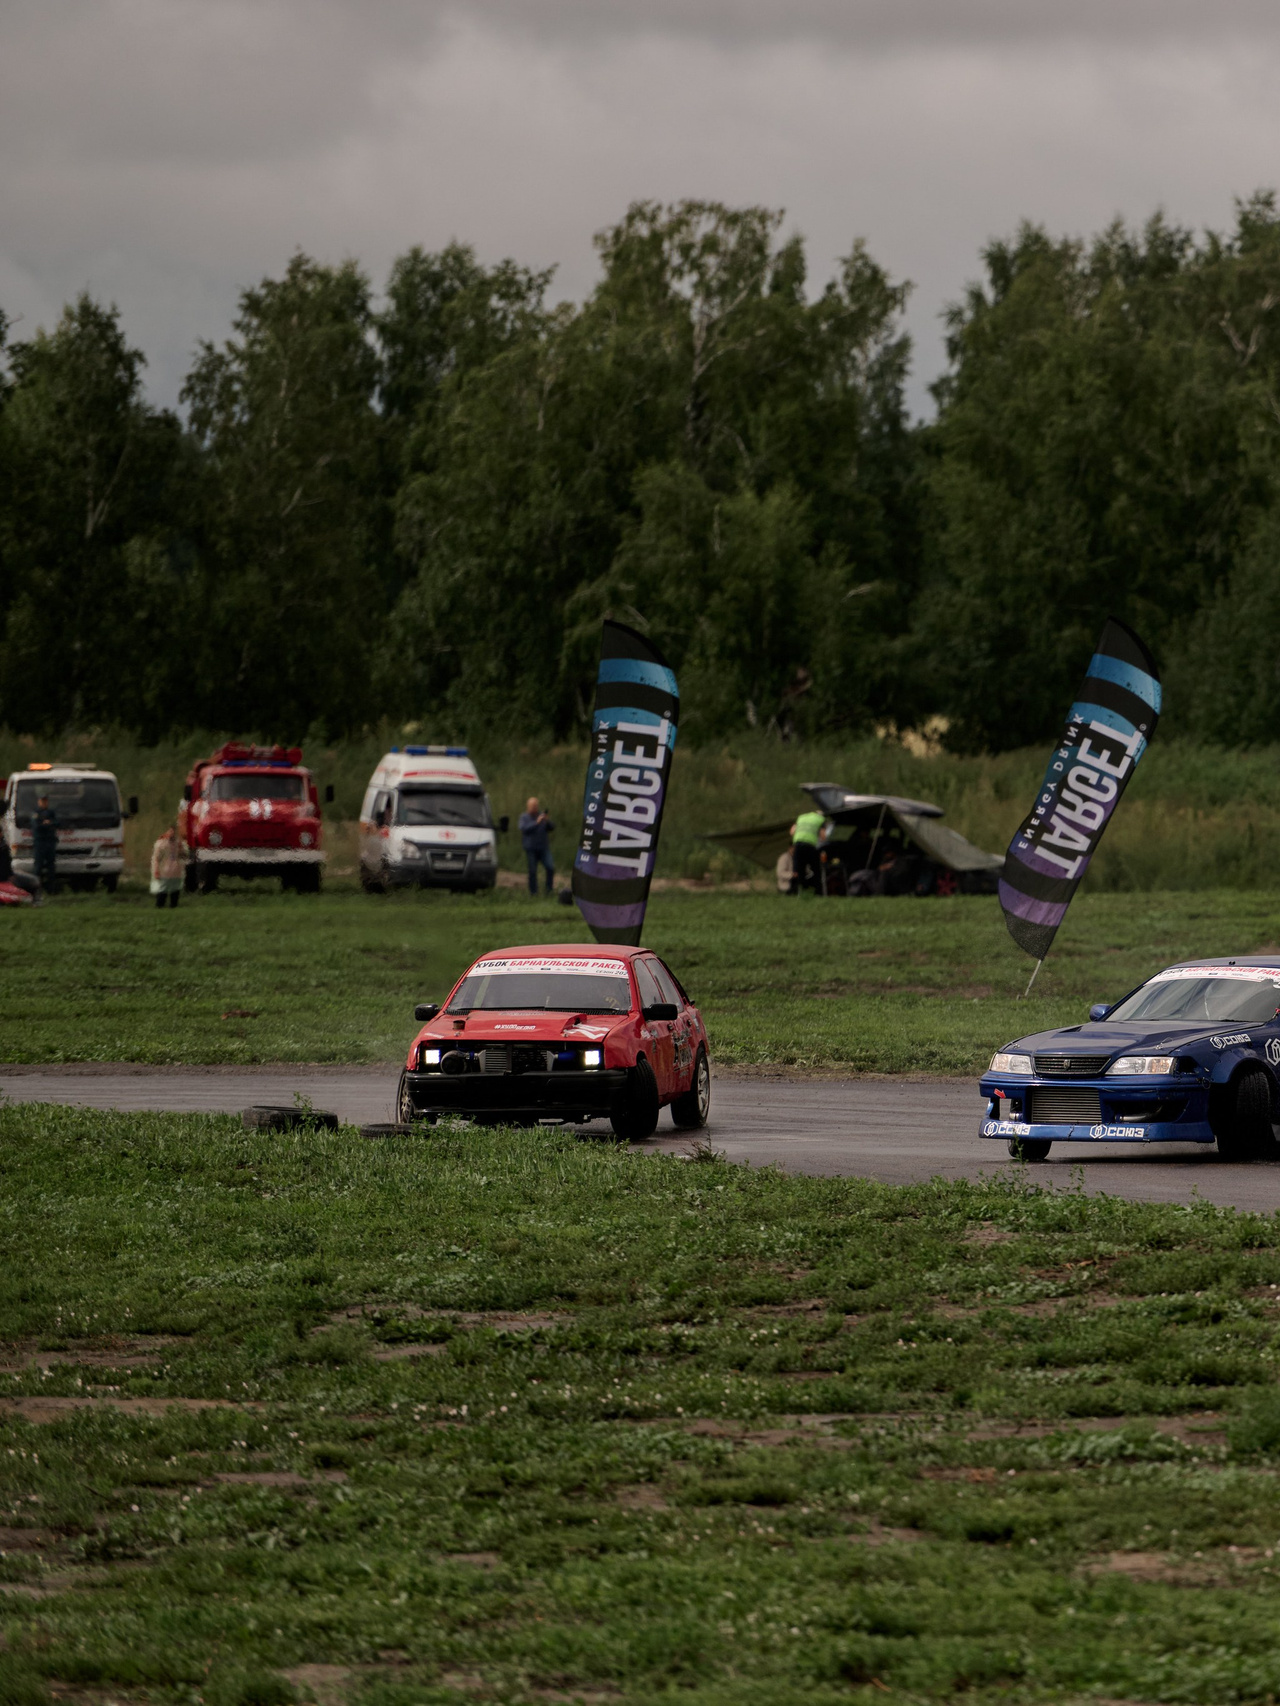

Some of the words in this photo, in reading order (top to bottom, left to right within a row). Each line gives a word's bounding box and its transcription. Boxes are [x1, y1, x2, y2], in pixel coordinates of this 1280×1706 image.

[476, 961, 509, 969] КУБОК
[1223, 1033, 1252, 1045] СОЮЗ
[998, 1125, 1031, 1135] СОЮЗ
[1107, 1126, 1145, 1138] СОЮЗ
